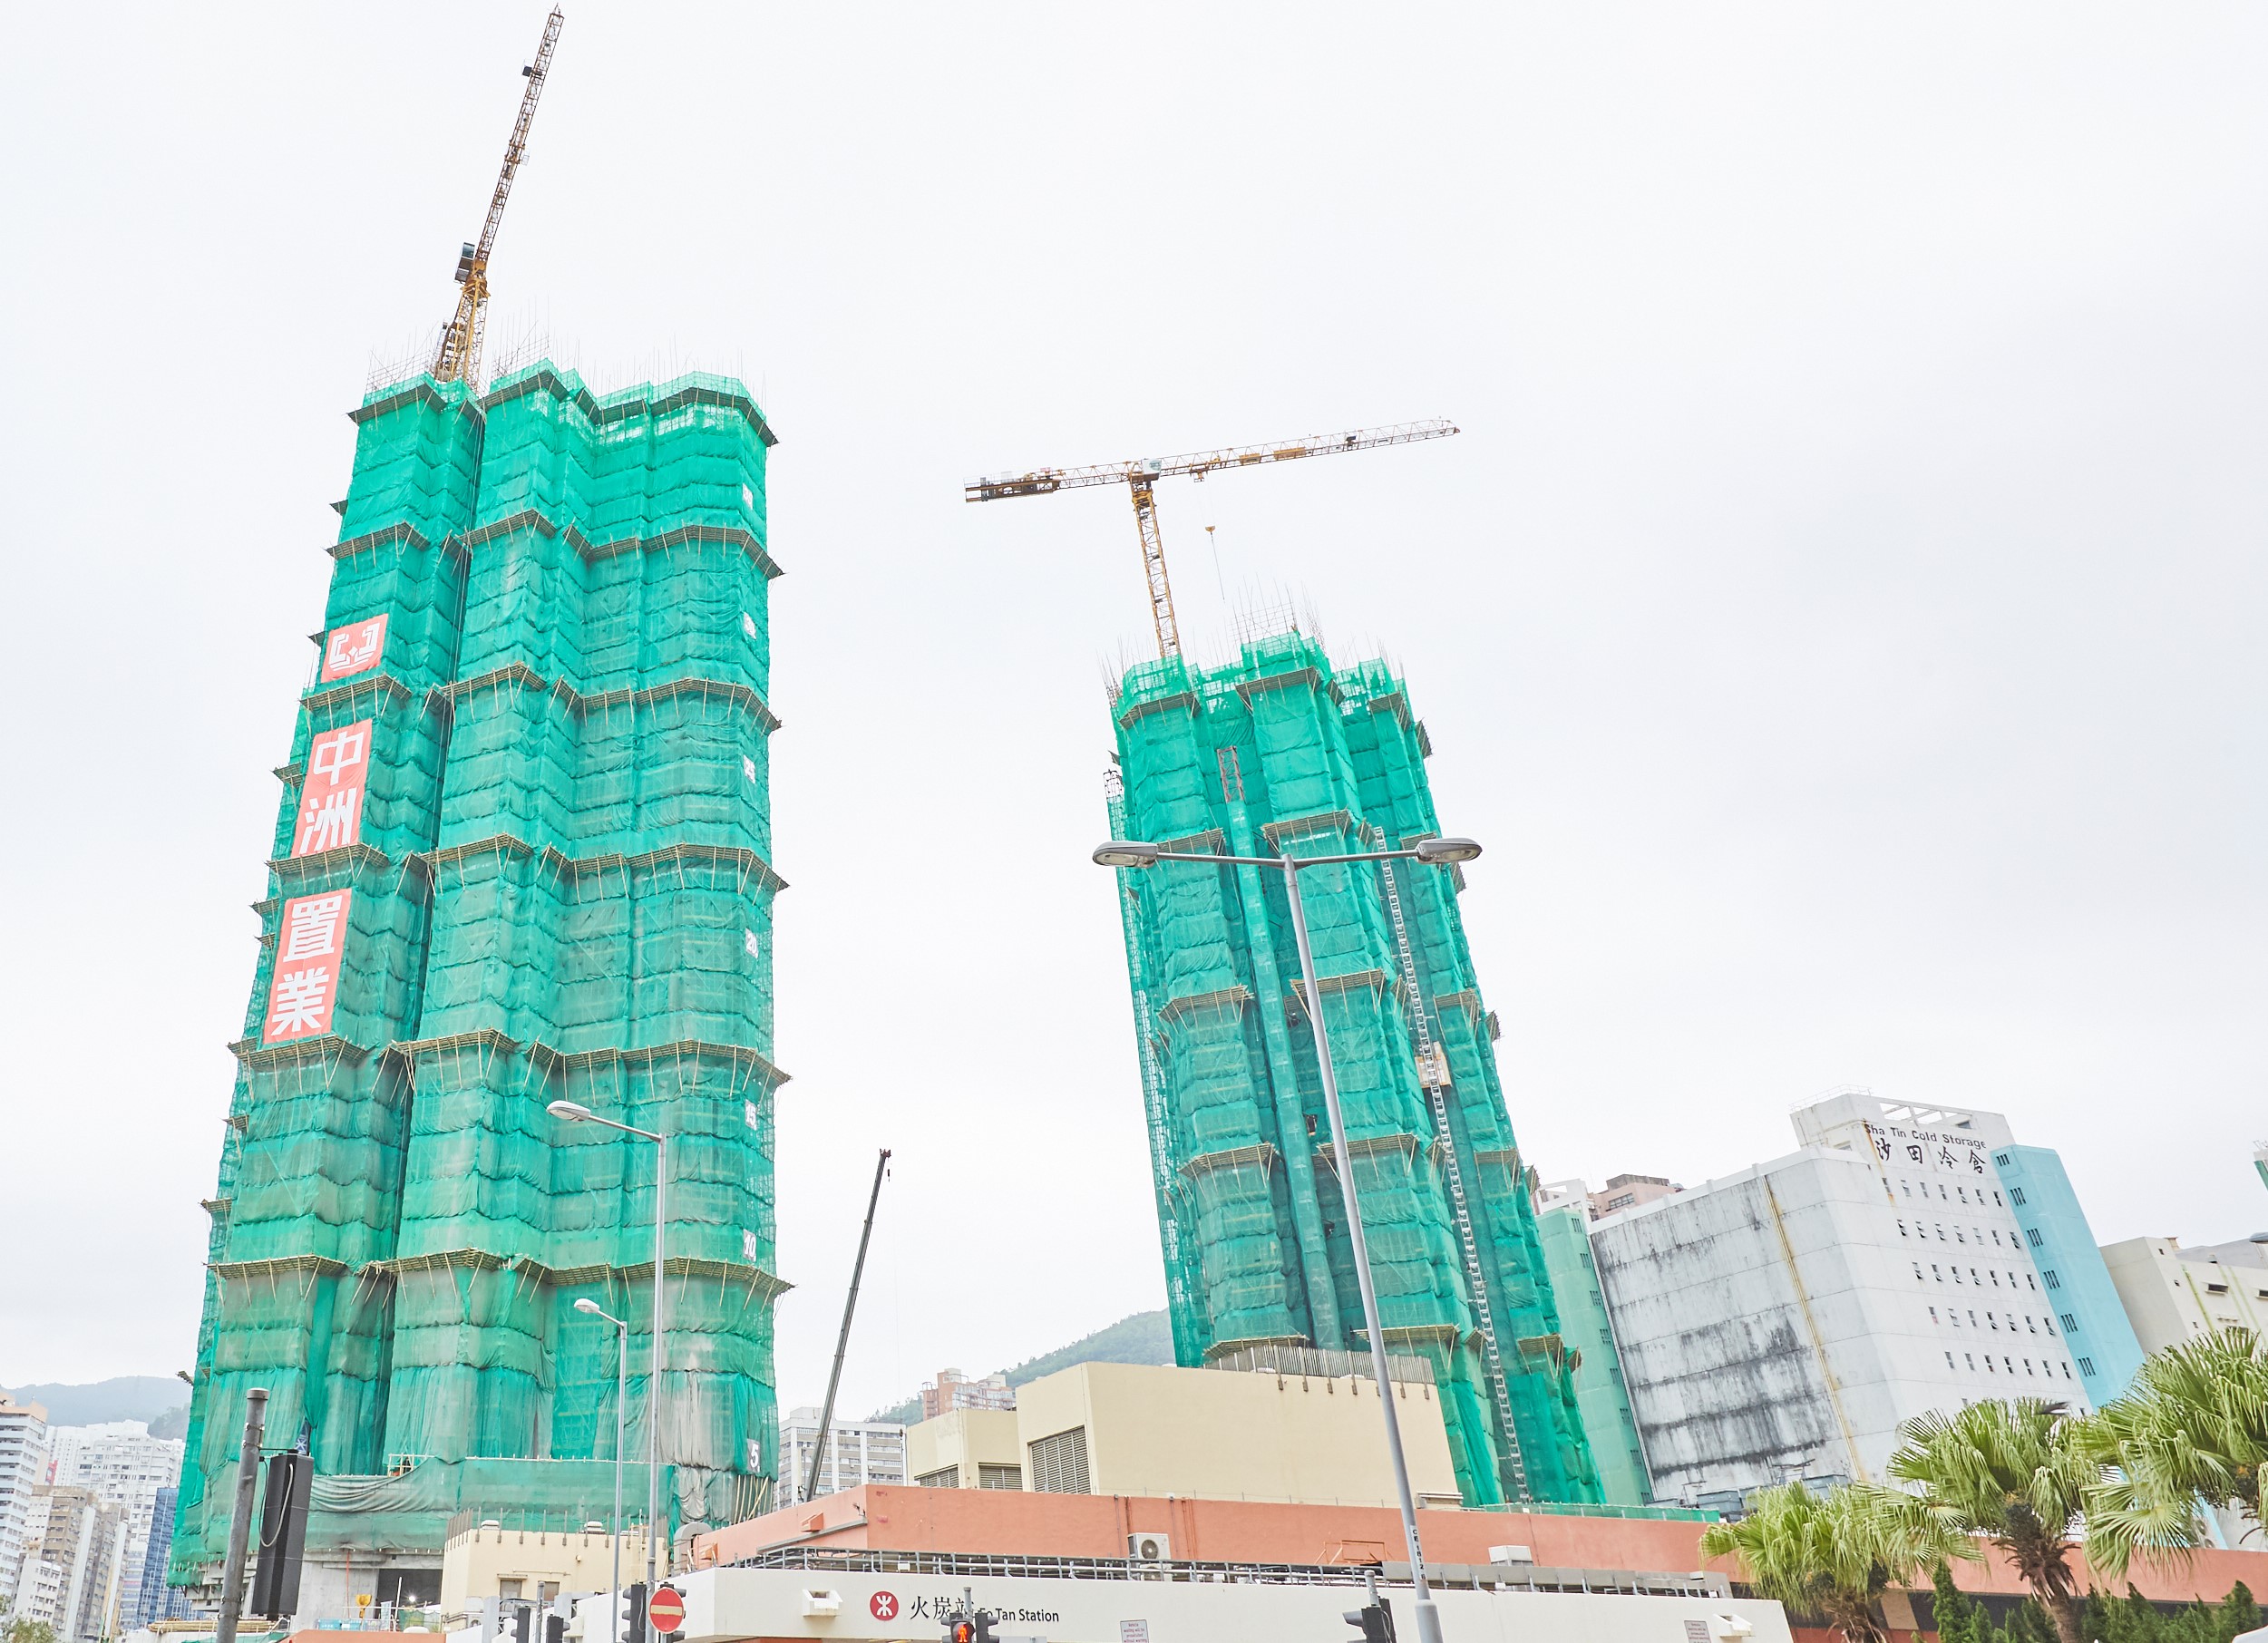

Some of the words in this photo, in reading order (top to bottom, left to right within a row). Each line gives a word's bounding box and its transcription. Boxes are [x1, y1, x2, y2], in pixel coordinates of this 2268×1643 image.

[299, 731, 365, 854] 中洲
[745, 932, 756, 954] 20
[270, 894, 344, 1038] 置業
[745, 1103, 756, 1126] 15
[1864, 1123, 1884, 1135] Sha
[1890, 1127, 1906, 1138] Tin
[1912, 1130, 1937, 1142] Cold
[1942, 1134, 1986, 1150] Storage
[745, 1234, 756, 1258] 10
[750, 1443, 759, 1468] 5
[995, 1608, 1016, 1621] Tan
[1019, 1609, 1059, 1622] Station
